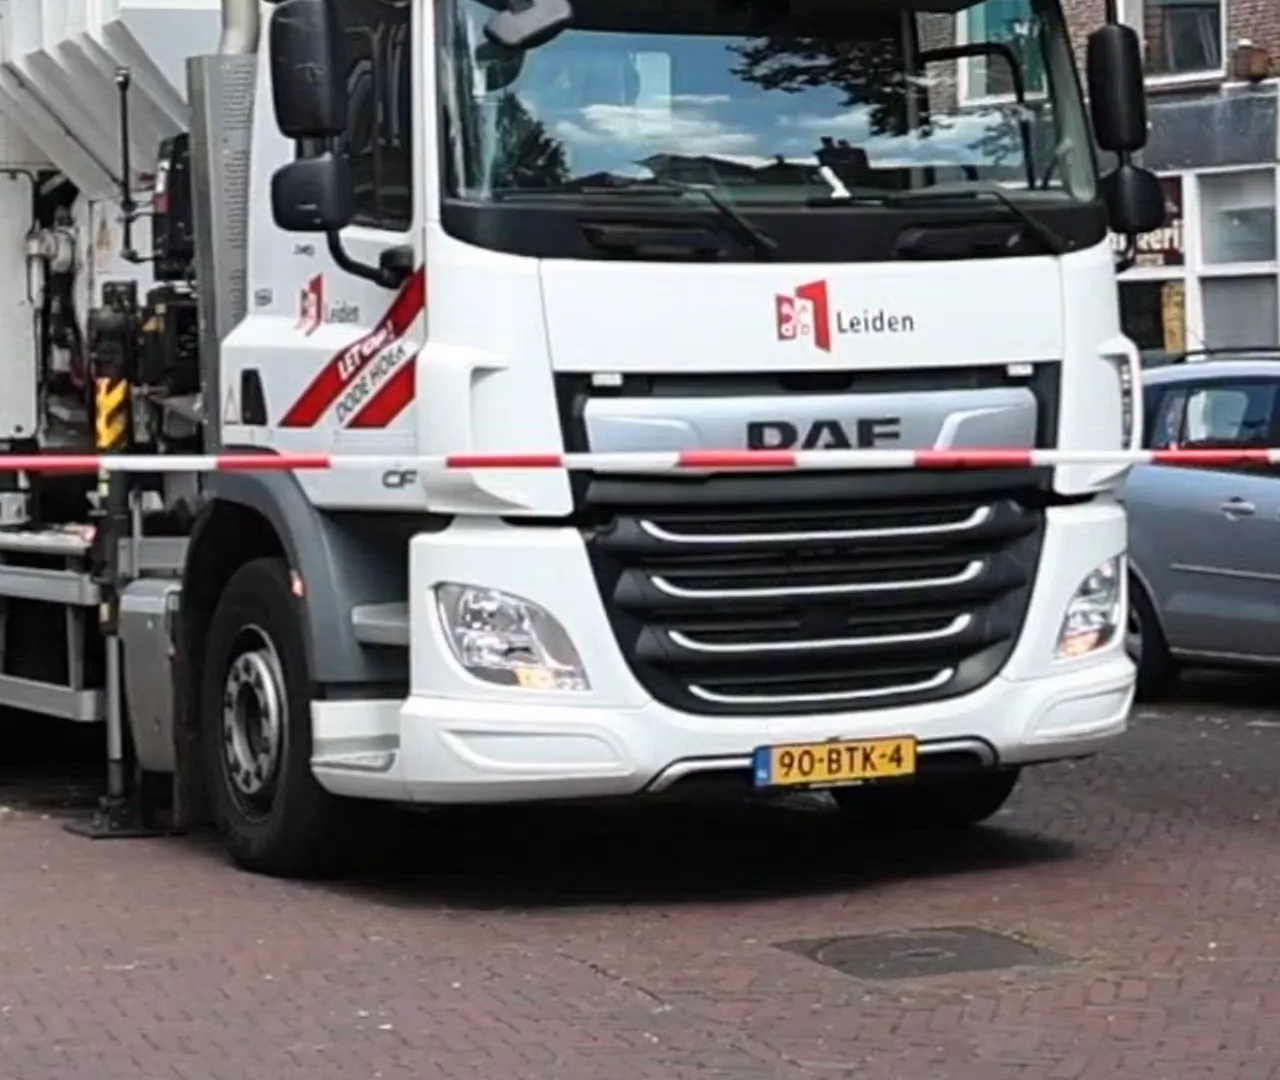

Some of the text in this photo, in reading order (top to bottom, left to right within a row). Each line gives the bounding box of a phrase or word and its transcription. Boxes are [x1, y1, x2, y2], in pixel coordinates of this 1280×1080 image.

[836, 309, 915, 334] Leiden
[336, 343, 363, 381] LET
[334, 376, 371, 423] DODE
[747, 417, 902, 450] DAF
[382, 469, 417, 489] CF
[778, 743, 904, 777] 90-BTK-4
